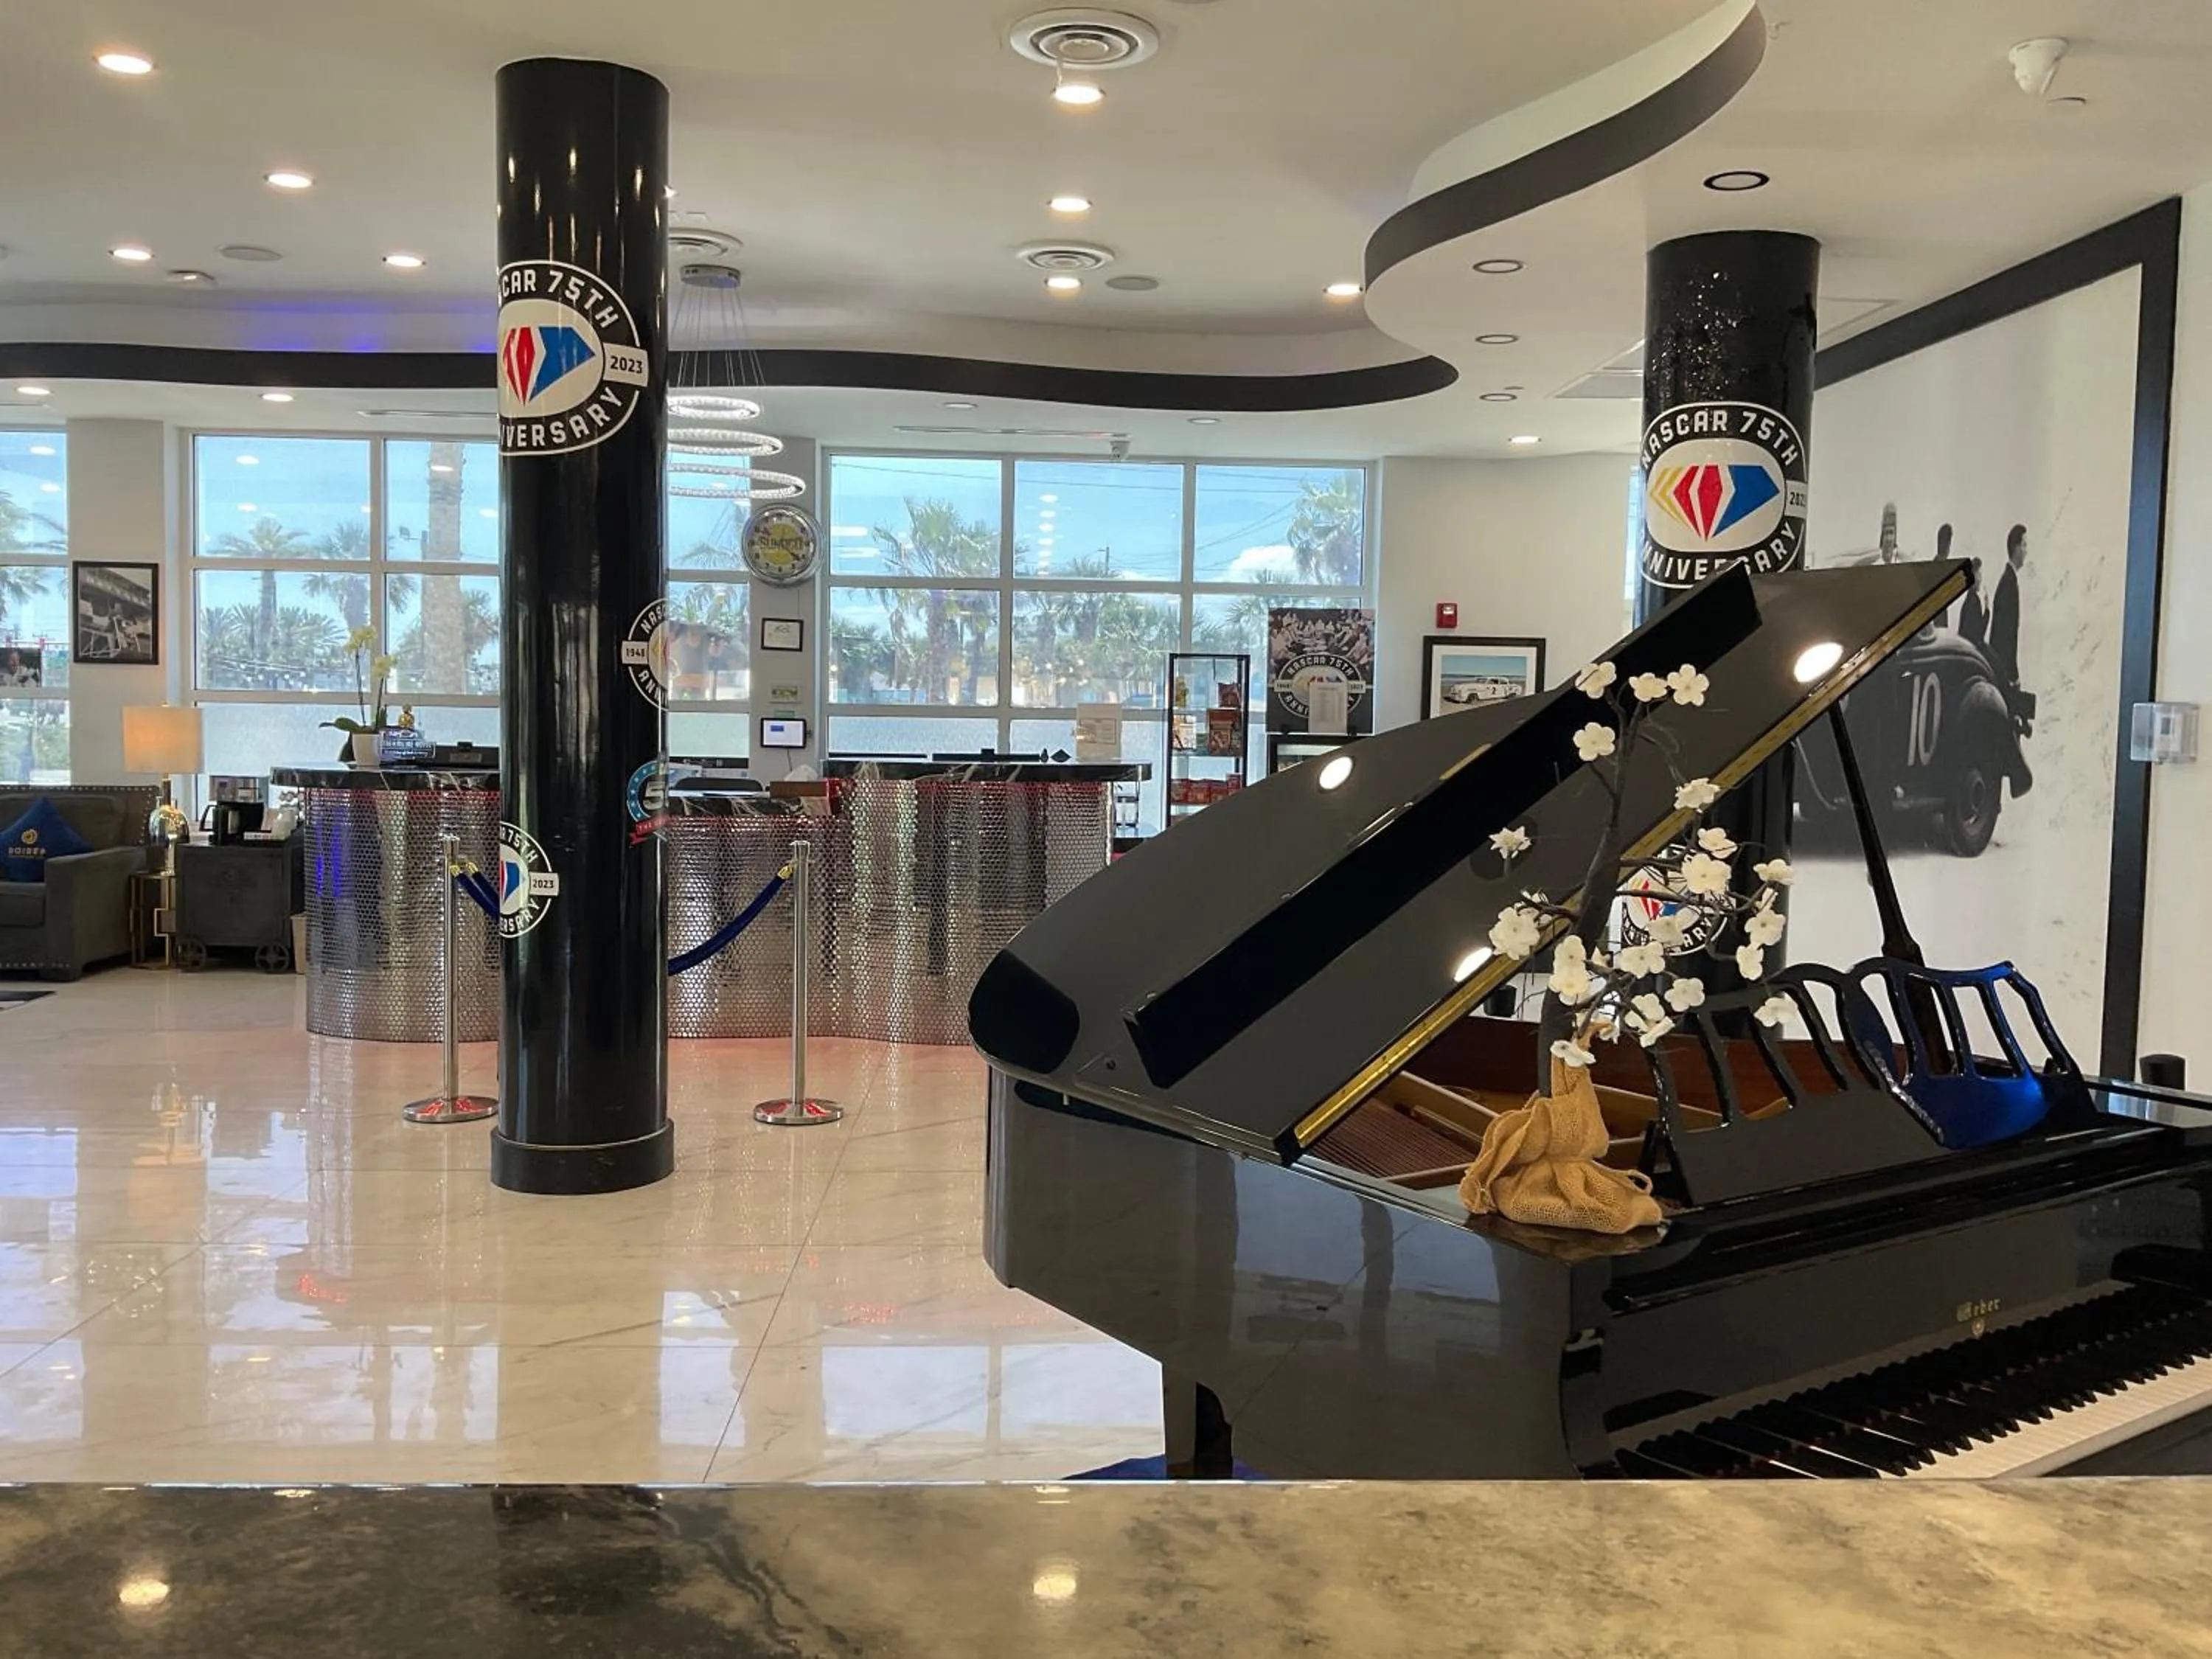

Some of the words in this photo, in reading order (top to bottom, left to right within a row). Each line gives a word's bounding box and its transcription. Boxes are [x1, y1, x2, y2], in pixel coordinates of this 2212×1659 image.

[501, 269, 537, 298] CAR
[548, 270, 619, 329] 75TH
[610, 355, 642, 374] 2023
[1642, 409, 1728, 470] NASCAR
[1739, 410, 1798, 466] 75TH
[1287, 655, 1326, 675] NASCAR
[1329, 657, 1354, 676] 75TH
[1907, 672, 1941, 766] 10
[508, 829, 538, 863] 75TH
[532, 879, 554, 888] 2023
